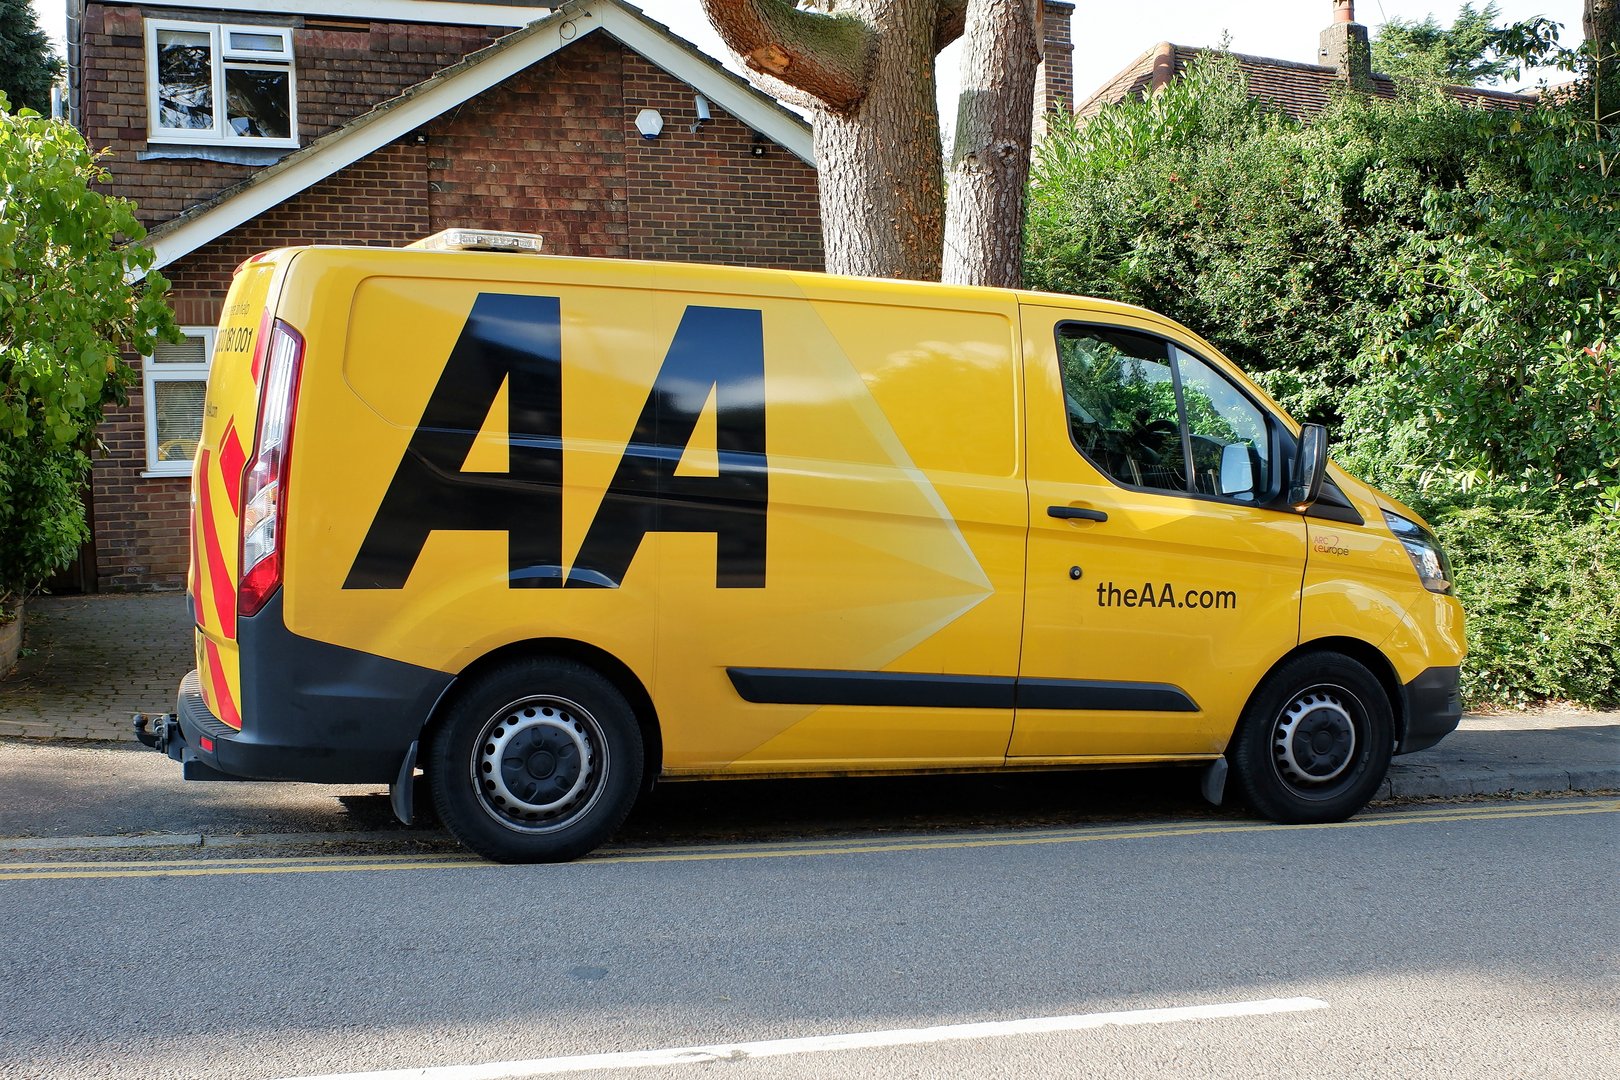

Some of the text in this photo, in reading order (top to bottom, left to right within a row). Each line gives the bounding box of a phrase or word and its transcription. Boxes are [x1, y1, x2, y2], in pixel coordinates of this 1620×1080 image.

[341, 292, 768, 589] AA
[1314, 536, 1328, 545] ARC
[1318, 545, 1349, 557] europe
[1096, 582, 1237, 609] theAA.com
